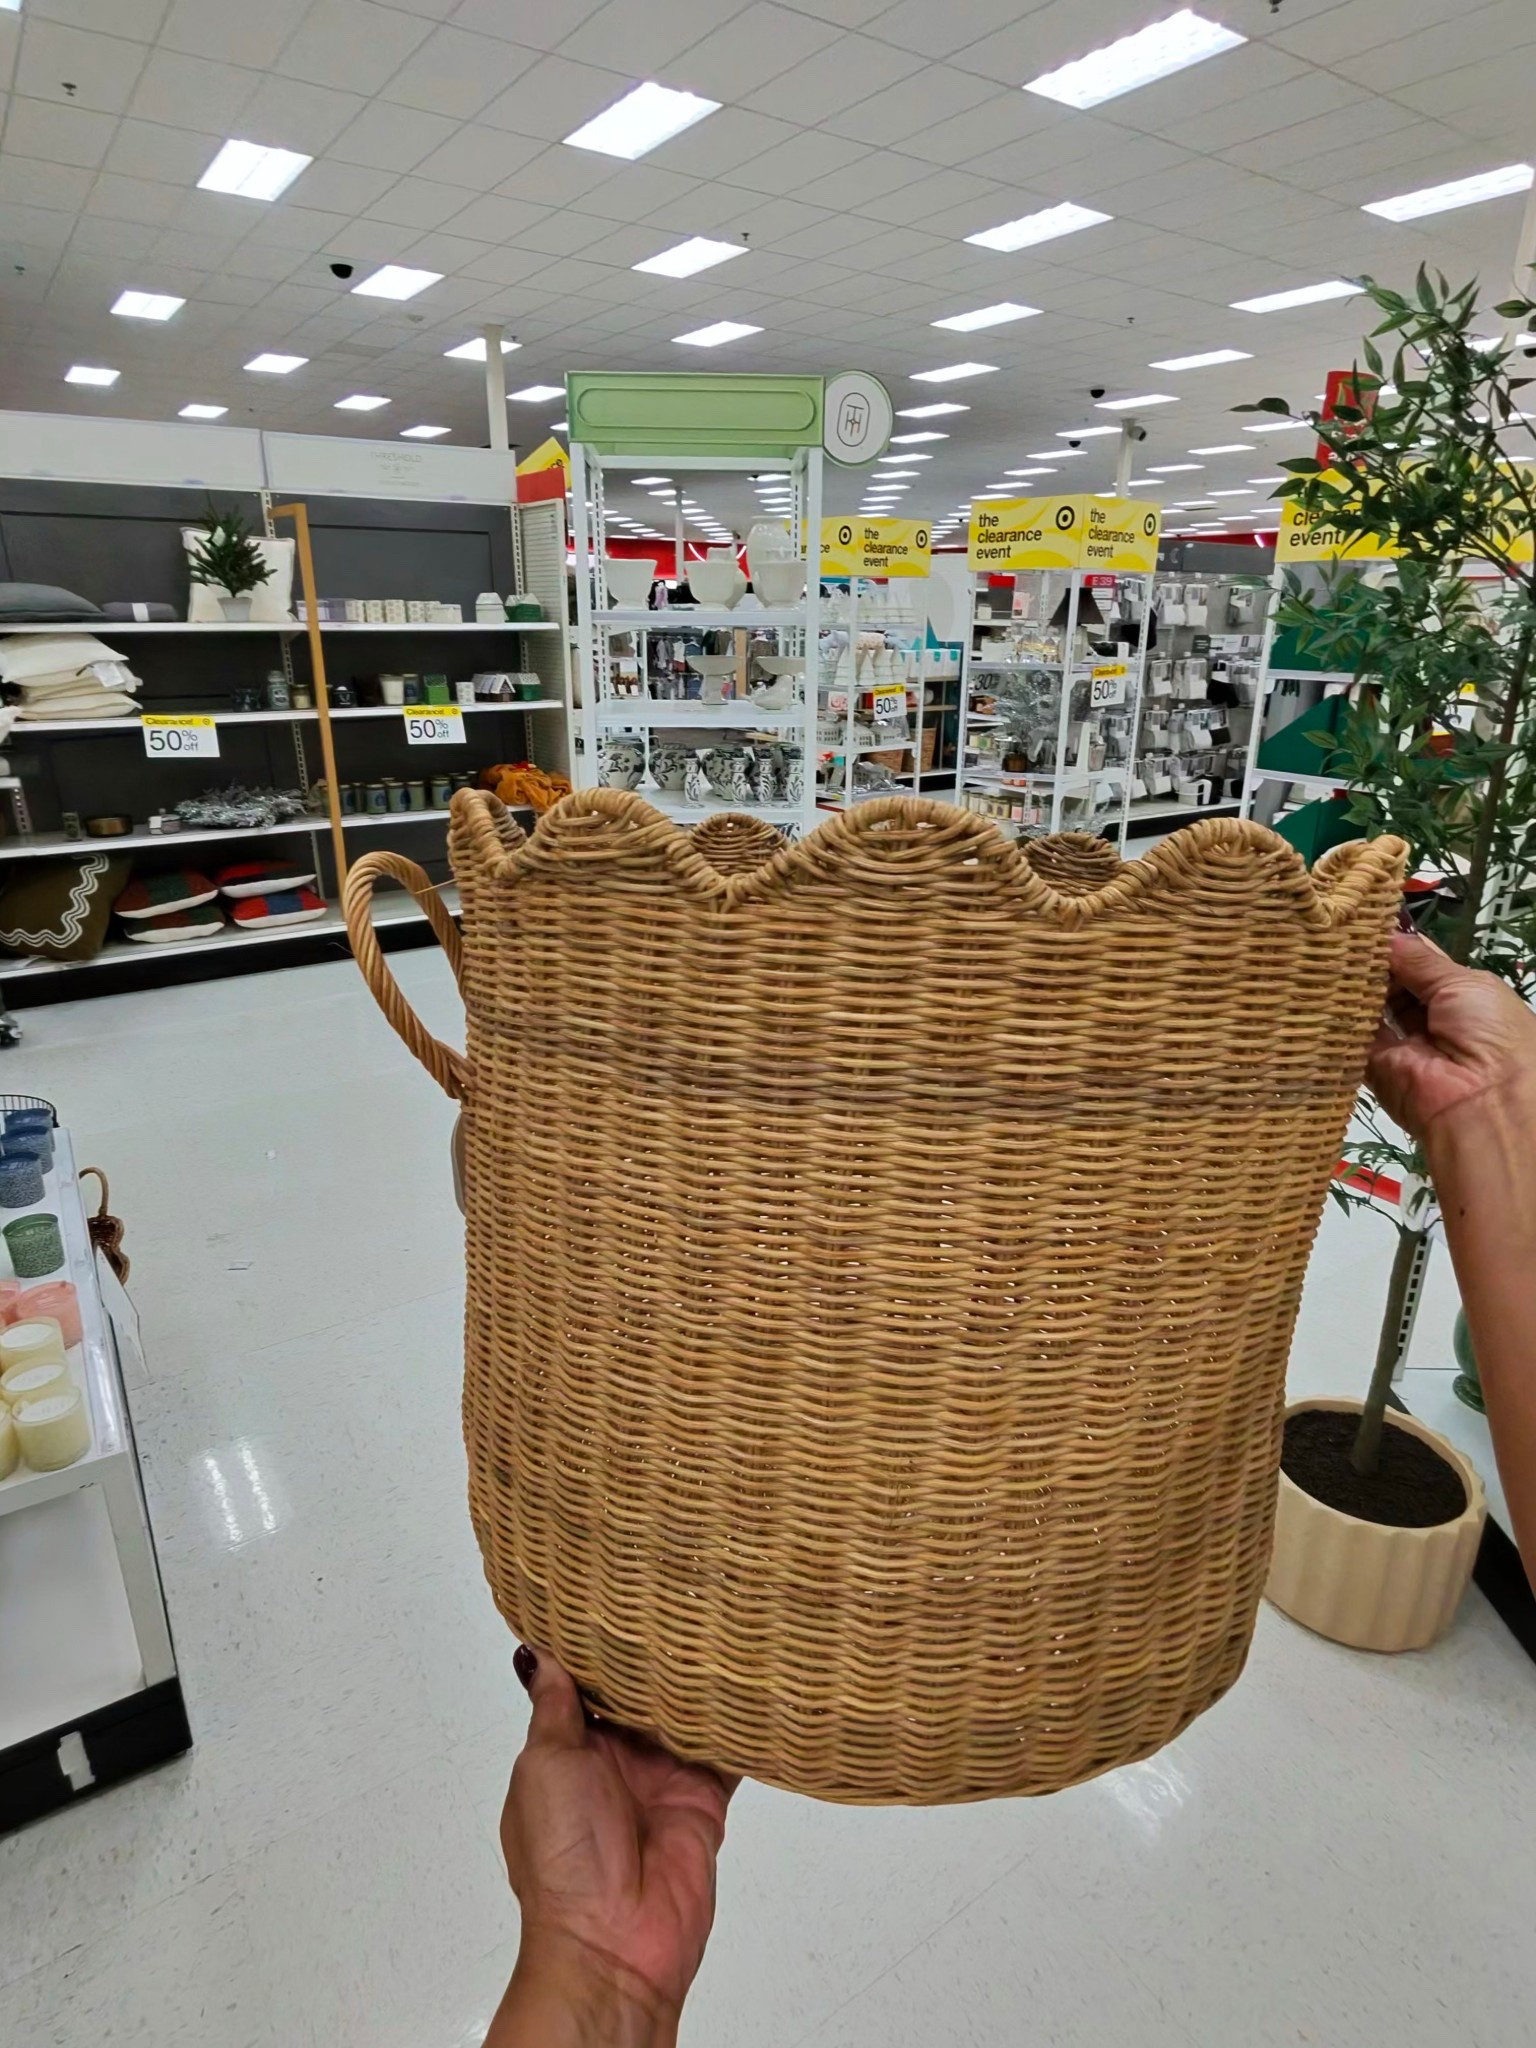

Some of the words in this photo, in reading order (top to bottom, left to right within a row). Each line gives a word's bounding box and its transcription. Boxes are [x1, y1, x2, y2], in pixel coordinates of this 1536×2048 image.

[978, 513, 1000, 527] the
[1090, 508, 1106, 523] the
[863, 527, 880, 540] the
[977, 529, 1043, 544] clearance
[1088, 526, 1135, 543] clearance
[1289, 530, 1341, 547] event
[863, 542, 909, 555] clearance
[976, 545, 1011, 559] event
[1087, 544, 1114, 558] event
[863, 556, 889, 567] event
[183, 743, 199, 751] off
